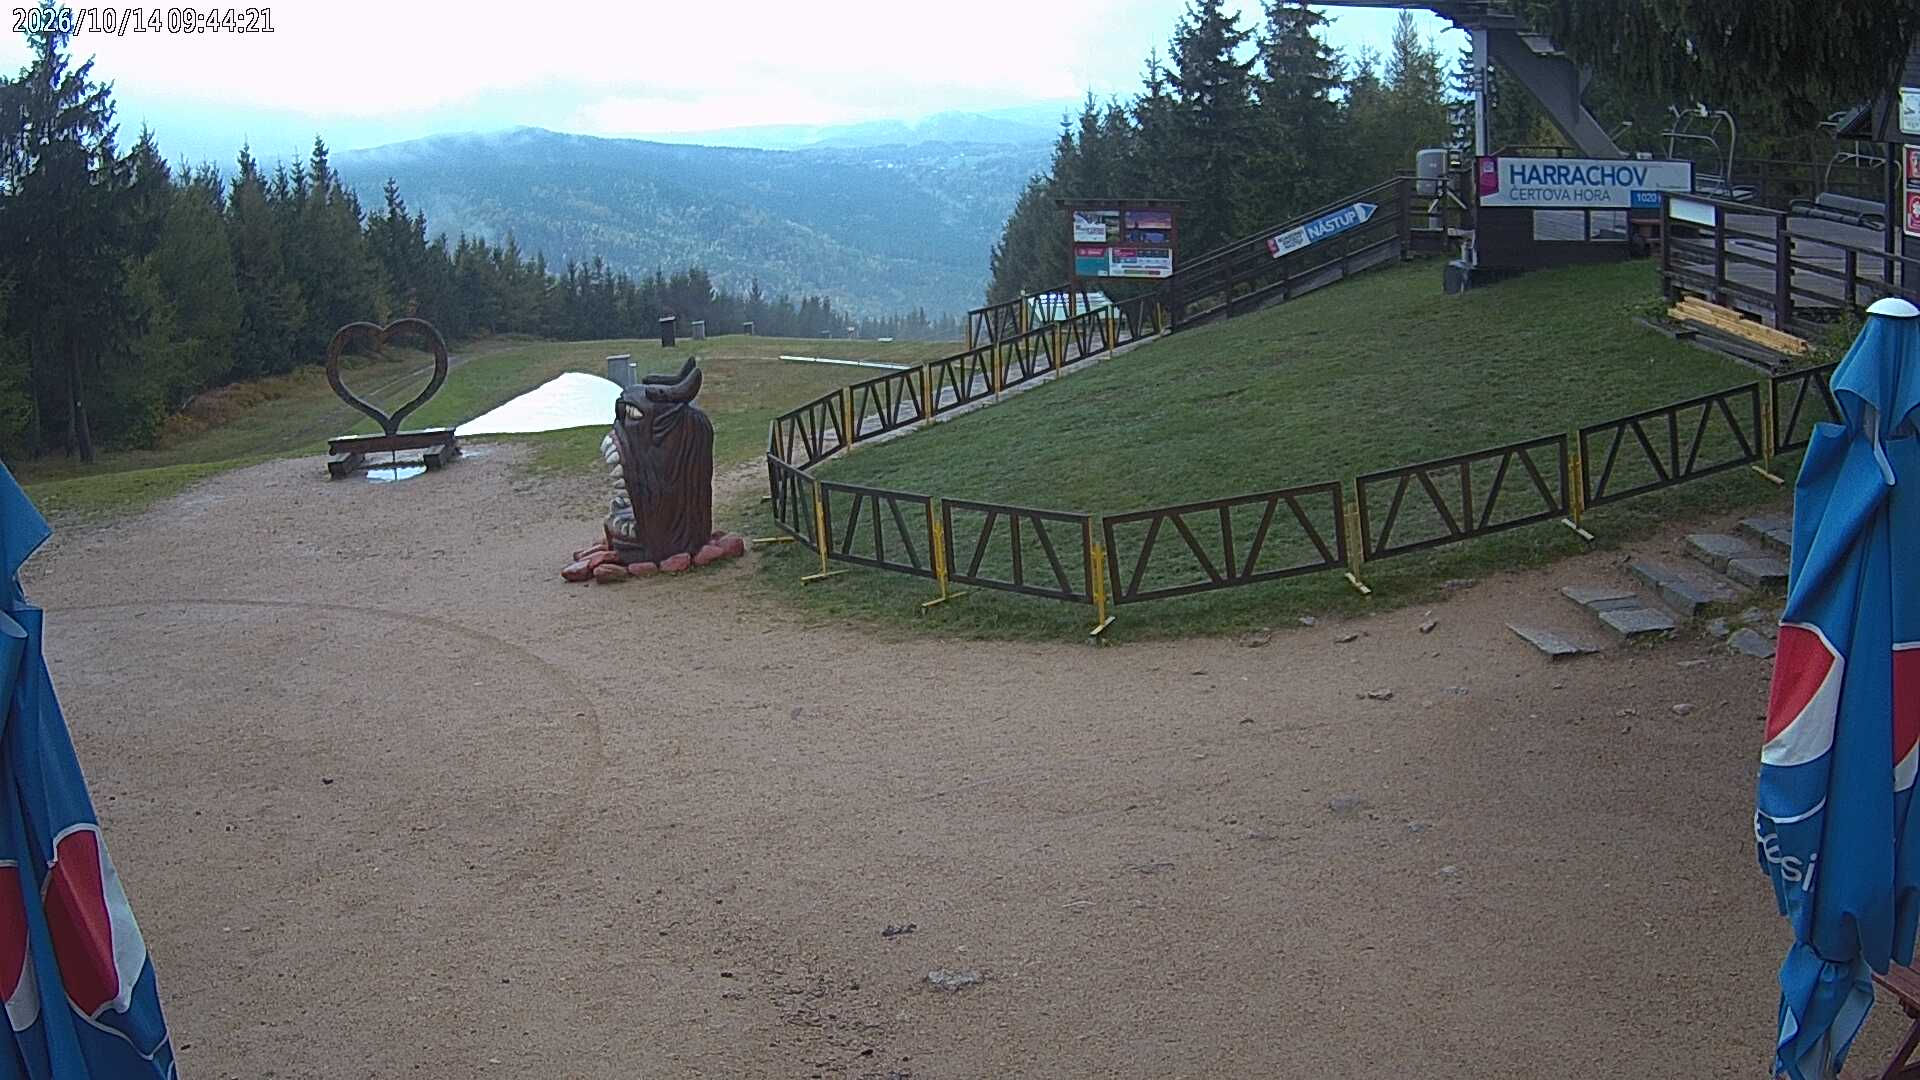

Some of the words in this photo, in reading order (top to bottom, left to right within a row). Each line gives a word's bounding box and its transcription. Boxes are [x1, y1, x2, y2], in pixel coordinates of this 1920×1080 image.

[1509, 164, 1648, 187] HARRACHOV
[1509, 187, 1570, 201] ČERTOVA
[1573, 188, 1611, 201] HORA
